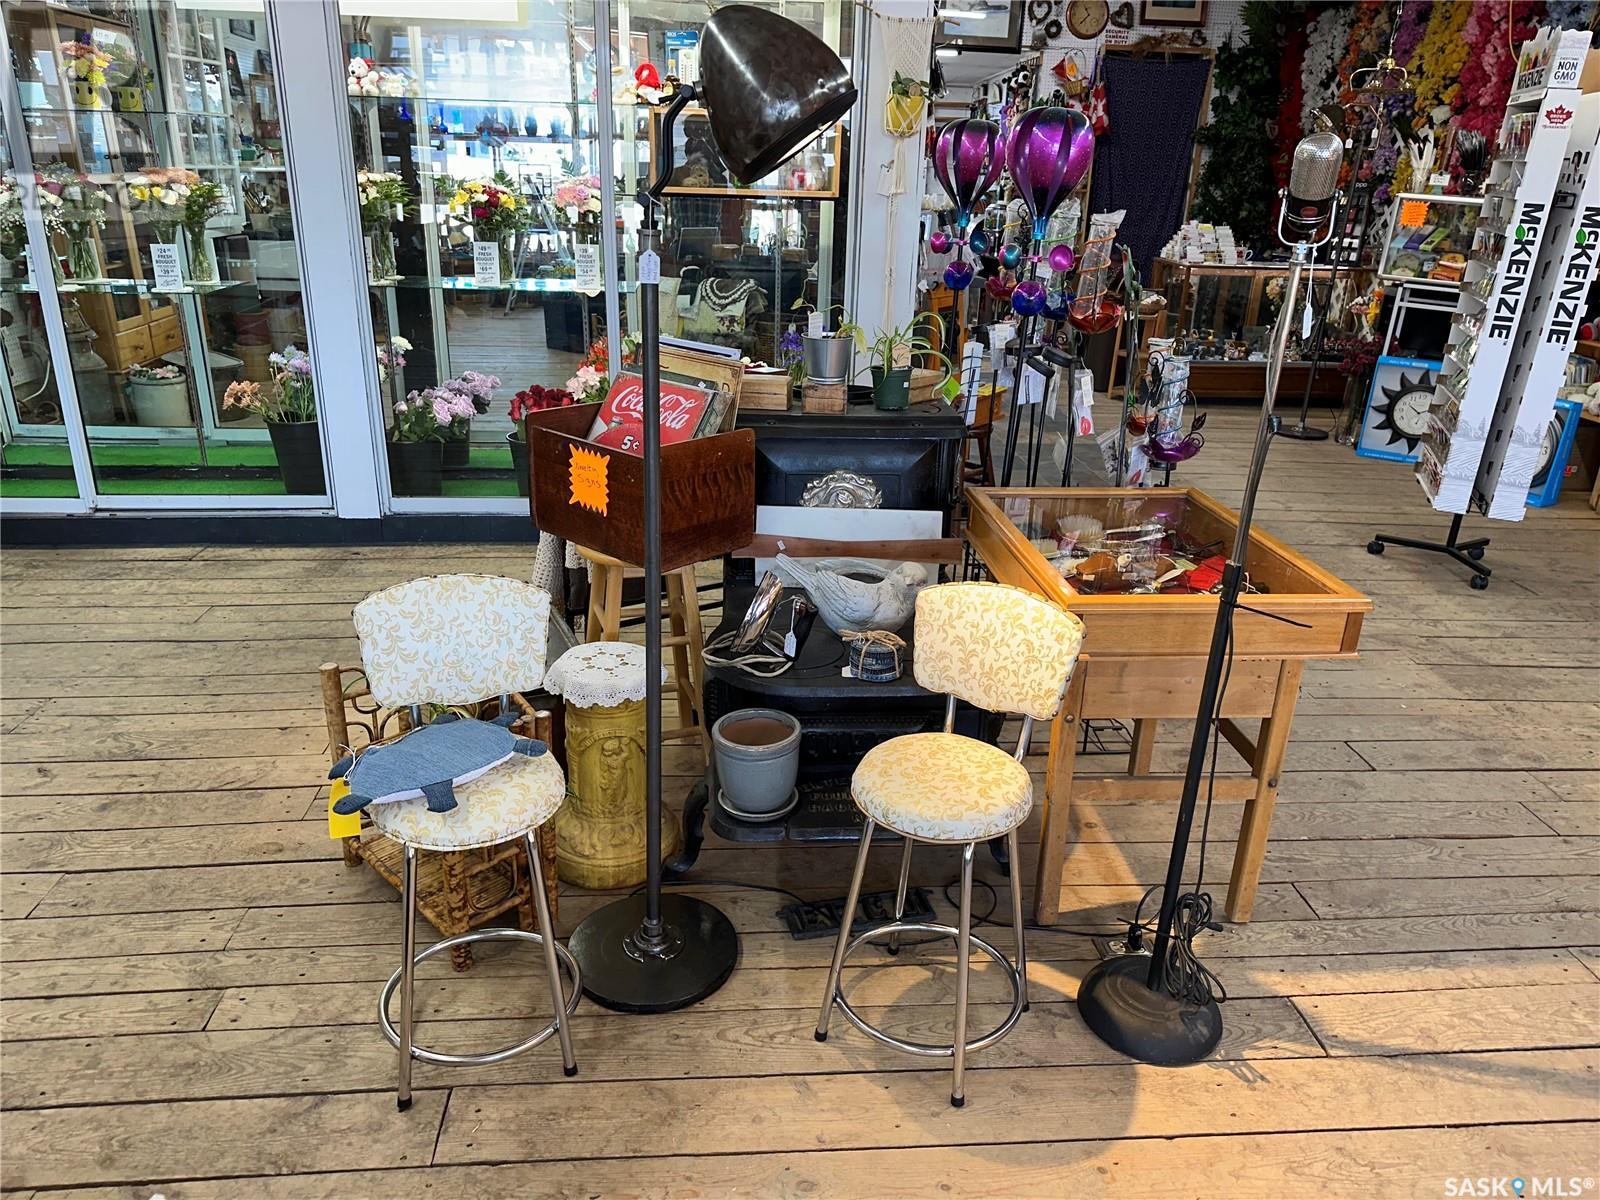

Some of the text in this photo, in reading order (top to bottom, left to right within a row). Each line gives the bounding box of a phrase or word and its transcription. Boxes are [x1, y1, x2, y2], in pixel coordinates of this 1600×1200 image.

[1557, 61, 1579, 71] NON
[1553, 71, 1577, 81] GMO
[611, 385, 698, 430] CocCola
[1541, 446, 1548, 455] 3
